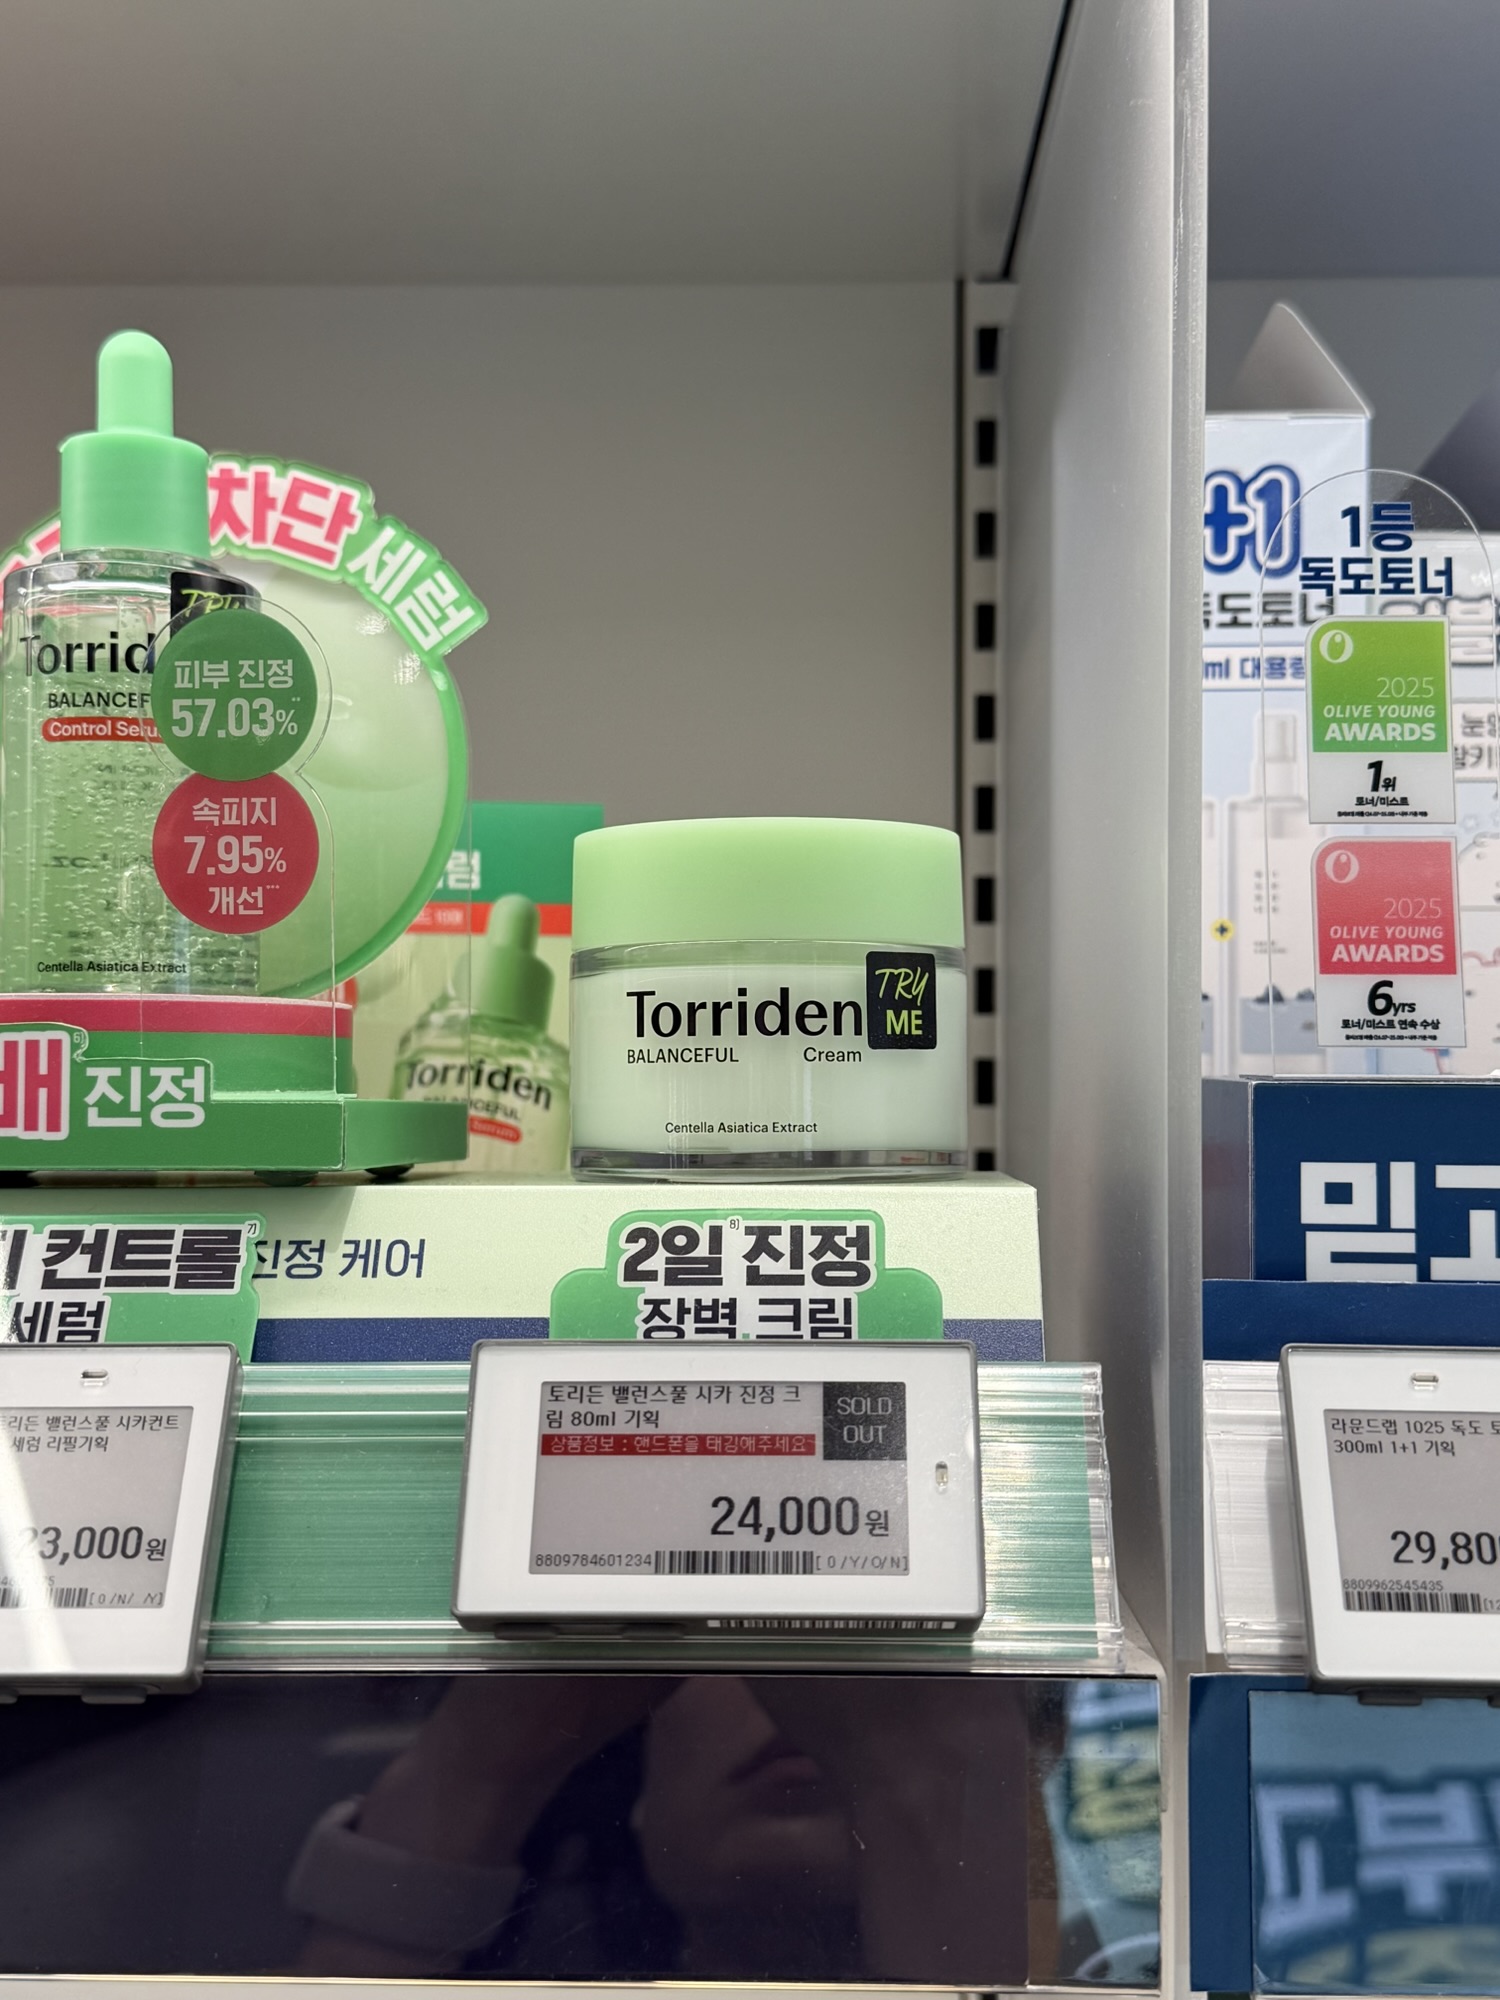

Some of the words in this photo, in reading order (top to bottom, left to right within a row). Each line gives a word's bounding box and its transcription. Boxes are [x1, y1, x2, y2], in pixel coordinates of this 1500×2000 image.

[1341, 502, 1415, 552] 1등
[208, 468, 358, 565] 차단
[346, 525, 475, 652] 세럼
[1299, 557, 1453, 597] 독도토너
[174, 660, 230, 689] 피부
[238, 659, 294, 689] 진정
[1377, 677, 1434, 698] 2025
[171, 697, 298, 738] 57.03%
[1323, 704, 1372, 718] OLIVE
[1378, 704, 1436, 718] YOUNG
[50, 721, 112, 736] Control
[1324, 722, 1436, 742] AWARDS
[1367, 760, 1397, 792] 1위
[192, 797, 277, 826] 속피지
[183, 835, 287, 875] 7.95%
[208, 886, 264, 915] 개선
[1383, 897, 1442, 919] 2025
[1329, 926, 1379, 939] OLIVE
[1385, 926, 1444, 939] YOUNG
[1331, 943, 1445, 963] AWARDS
[37, 961, 83, 973] Centella
[87, 961, 139, 973] Asiatica
[875, 966, 929, 1006] TRY
[626, 986, 863, 1038] Torriden
[886, 1009, 923, 1036] ME
[627, 1048, 739, 1064] BALANCEFUL
[803, 1047, 862, 1063] Cream
[84, 1066, 206, 1128] 진정
[665, 1122, 714, 1134] Centella
[717, 1122, 769, 1134] Asiatica
[772, 1122, 818, 1134] Extract
[41, 1229, 242, 1289] 컨트롤
[338, 1239, 425, 1278] 케어
[742, 1225, 871, 1287] 진정
[641, 1297, 737, 1339] 장벽
[756, 1298, 852, 1339] 크림
[547, 1385, 604, 1404] 토리든
[611, 1385, 688, 1405] 밸런스풀
[696, 1385, 732, 1404] 시카
[739, 1385, 775, 1404] 진정
[837, 1397, 892, 1415] SOLD
[45, 1415, 111, 1431] 밸런스풀
[116, 1415, 179, 1431] 시카컨트
[546, 1410, 562, 1428] 림
[570, 1411, 616, 1427] 80ml
[624, 1410, 660, 1427] 기획
[1331, 1418, 1397, 1435] 라운드랩
[1405, 1420, 1445, 1434] 1025
[1450, 1420, 1484, 1436] 독도
[12, 1436, 41, 1452] 세럼
[47, 1436, 109, 1452] 리필기획
[843, 1425, 887, 1443] OUT
[551, 1436, 615, 1453] 상품정보
[634, 1436, 699, 1453] 핸드폰을
[1333, 1440, 1383, 1454] 300ml
[1391, 1441, 1417, 1454] 1+1
[1424, 1440, 1456, 1456] 기획
[535, 1554, 651, 1568] 8809784601234
[1343, 1579, 1444, 1591] 8809962545435
